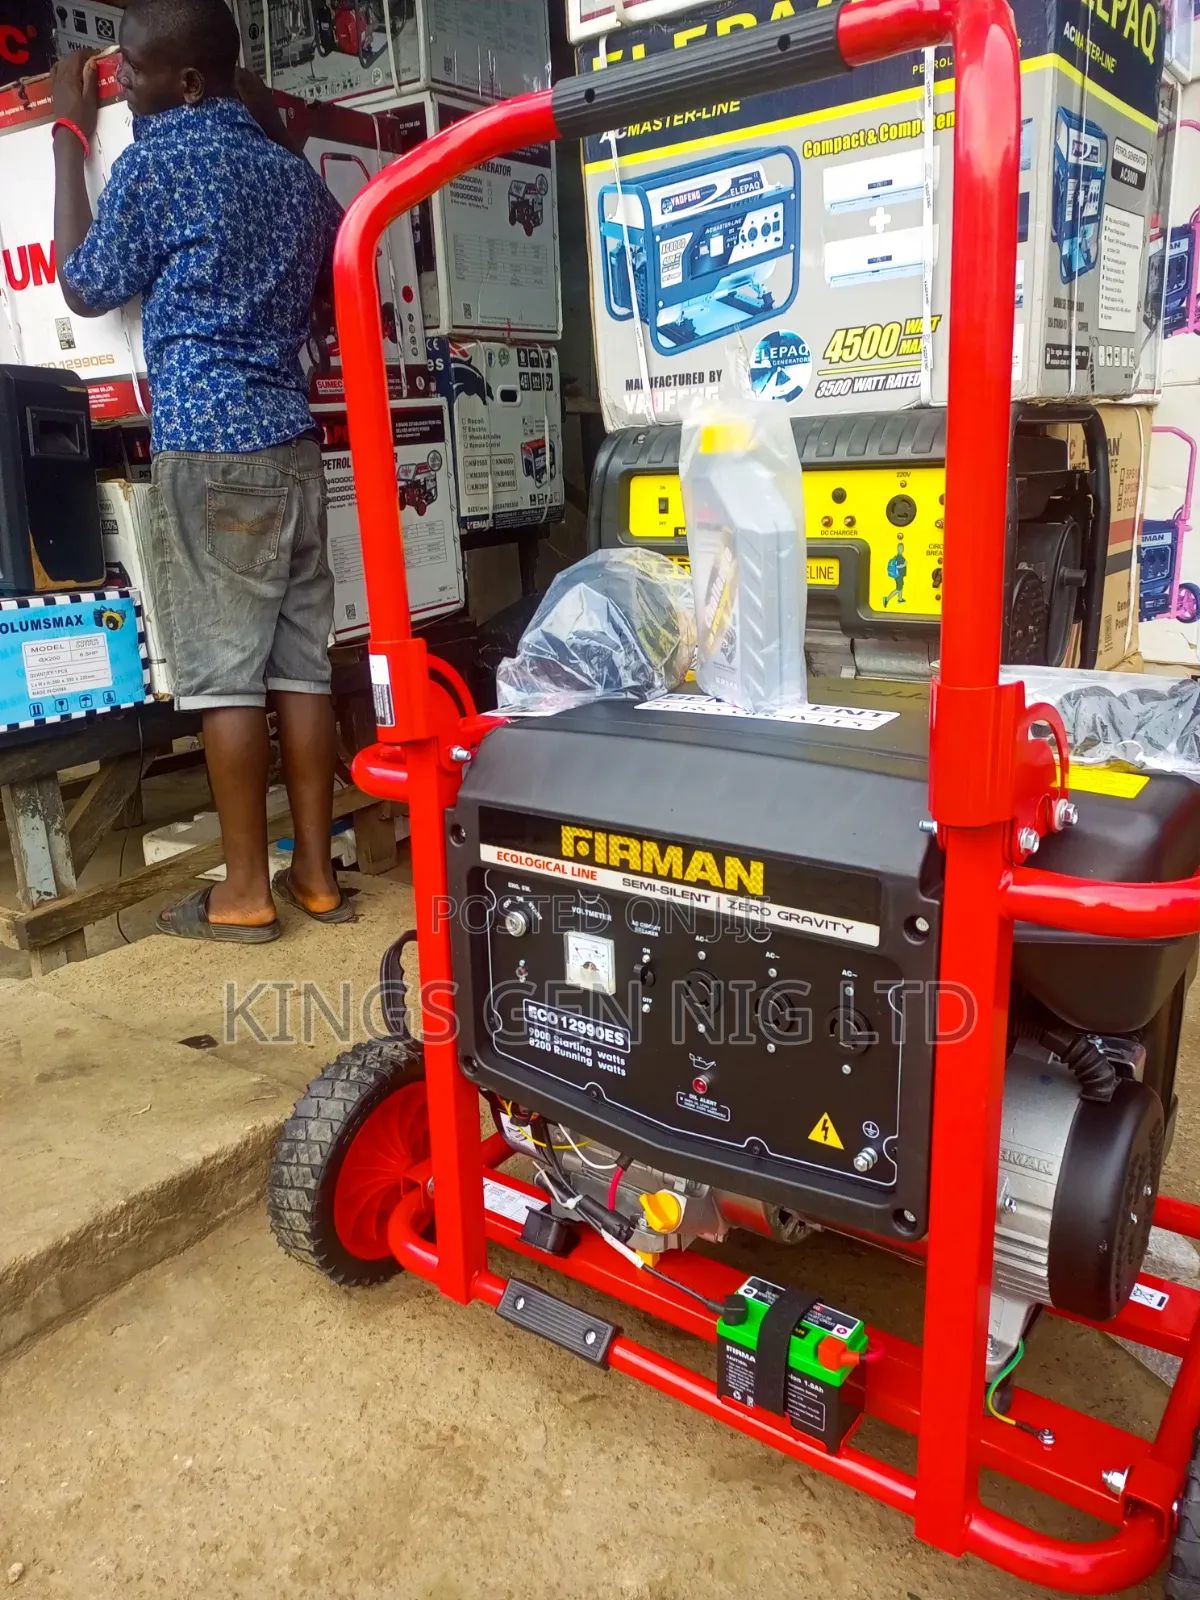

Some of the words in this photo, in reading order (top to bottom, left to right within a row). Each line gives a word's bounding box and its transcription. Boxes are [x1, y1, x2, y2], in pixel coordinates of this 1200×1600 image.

[913, 57, 952, 75] PEROL
[803, 129, 866, 159] Compact
[867, 128, 877, 145] &
[730, 181, 760, 196] ELEPAQ
[823, 322, 902, 364] 4500
[772, 356, 811, 366] GENERATORS
[317, 380, 343, 388] SUMEC
[709, 370, 722, 383] BY
[815, 379, 852, 398] 3500
[852, 375, 888, 394] WATT
[322, 458, 352, 471] PETROL
[31, 644, 65, 653] MODEL
[497, 851, 568, 874] ECOLOGICAL
[571, 866, 598, 881] LINE
[561, 825, 764, 896] FIRMAN
[571, 906, 612, 921] VOLTMETER
[622, 877, 711, 904] SEMI-SILENT
[727, 900, 772, 917] ZERO
[777, 910, 854, 934] GRAVITY
[640, 921, 661, 931] CIRCUIT
[528, 1005, 558, 1025] ECO
[561, 1015, 624, 1046] 12990ES
[529, 1028, 551, 1041] 9000
[553, 1035, 592, 1056] Starting
[597, 1050, 625, 1066] watts
[529, 1037, 551, 1051] 8200
[554, 1045, 592, 1067] Running
[598, 1061, 626, 1076] watts
[689, 1093, 698, 1101] OIL
[700, 1097, 717, 1106] ALERT
[726, 1345, 756, 1363] FIRMA
